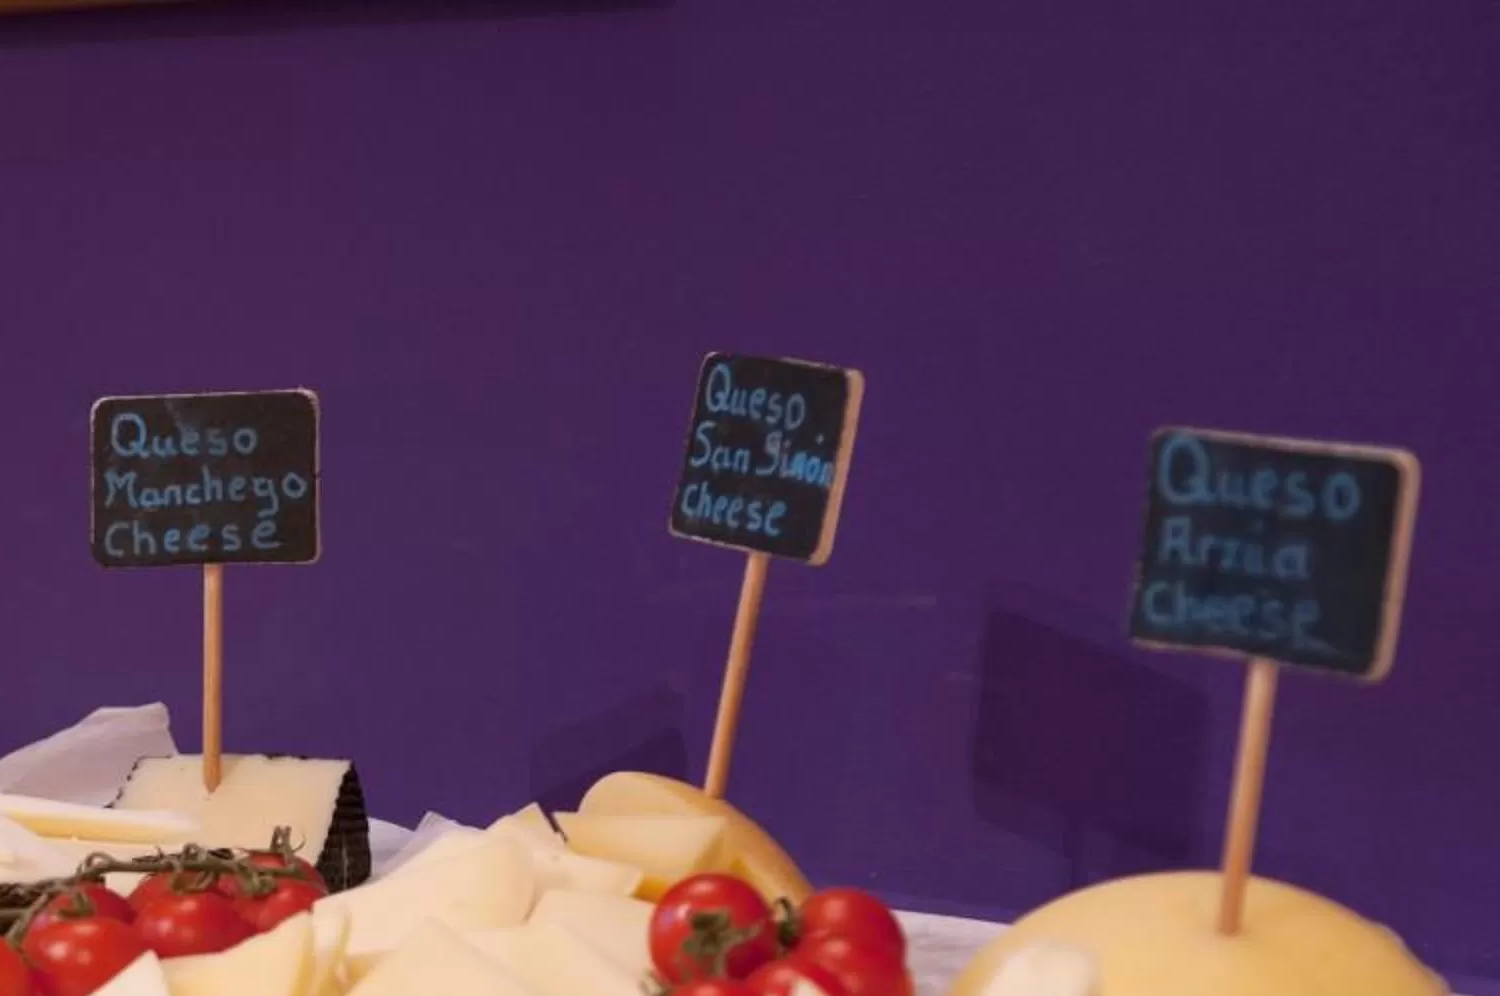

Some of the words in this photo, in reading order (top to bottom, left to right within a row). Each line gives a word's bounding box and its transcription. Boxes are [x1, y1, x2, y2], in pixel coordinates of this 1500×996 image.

[704, 362, 806, 431] Queso
[110, 411, 258, 459] Queso
[690, 420, 751, 473] San
[102, 463, 308, 518] Manchego
[1157, 433, 1362, 522] Queso
[679, 480, 788, 537] Cheese
[103, 519, 284, 558] Cheese
